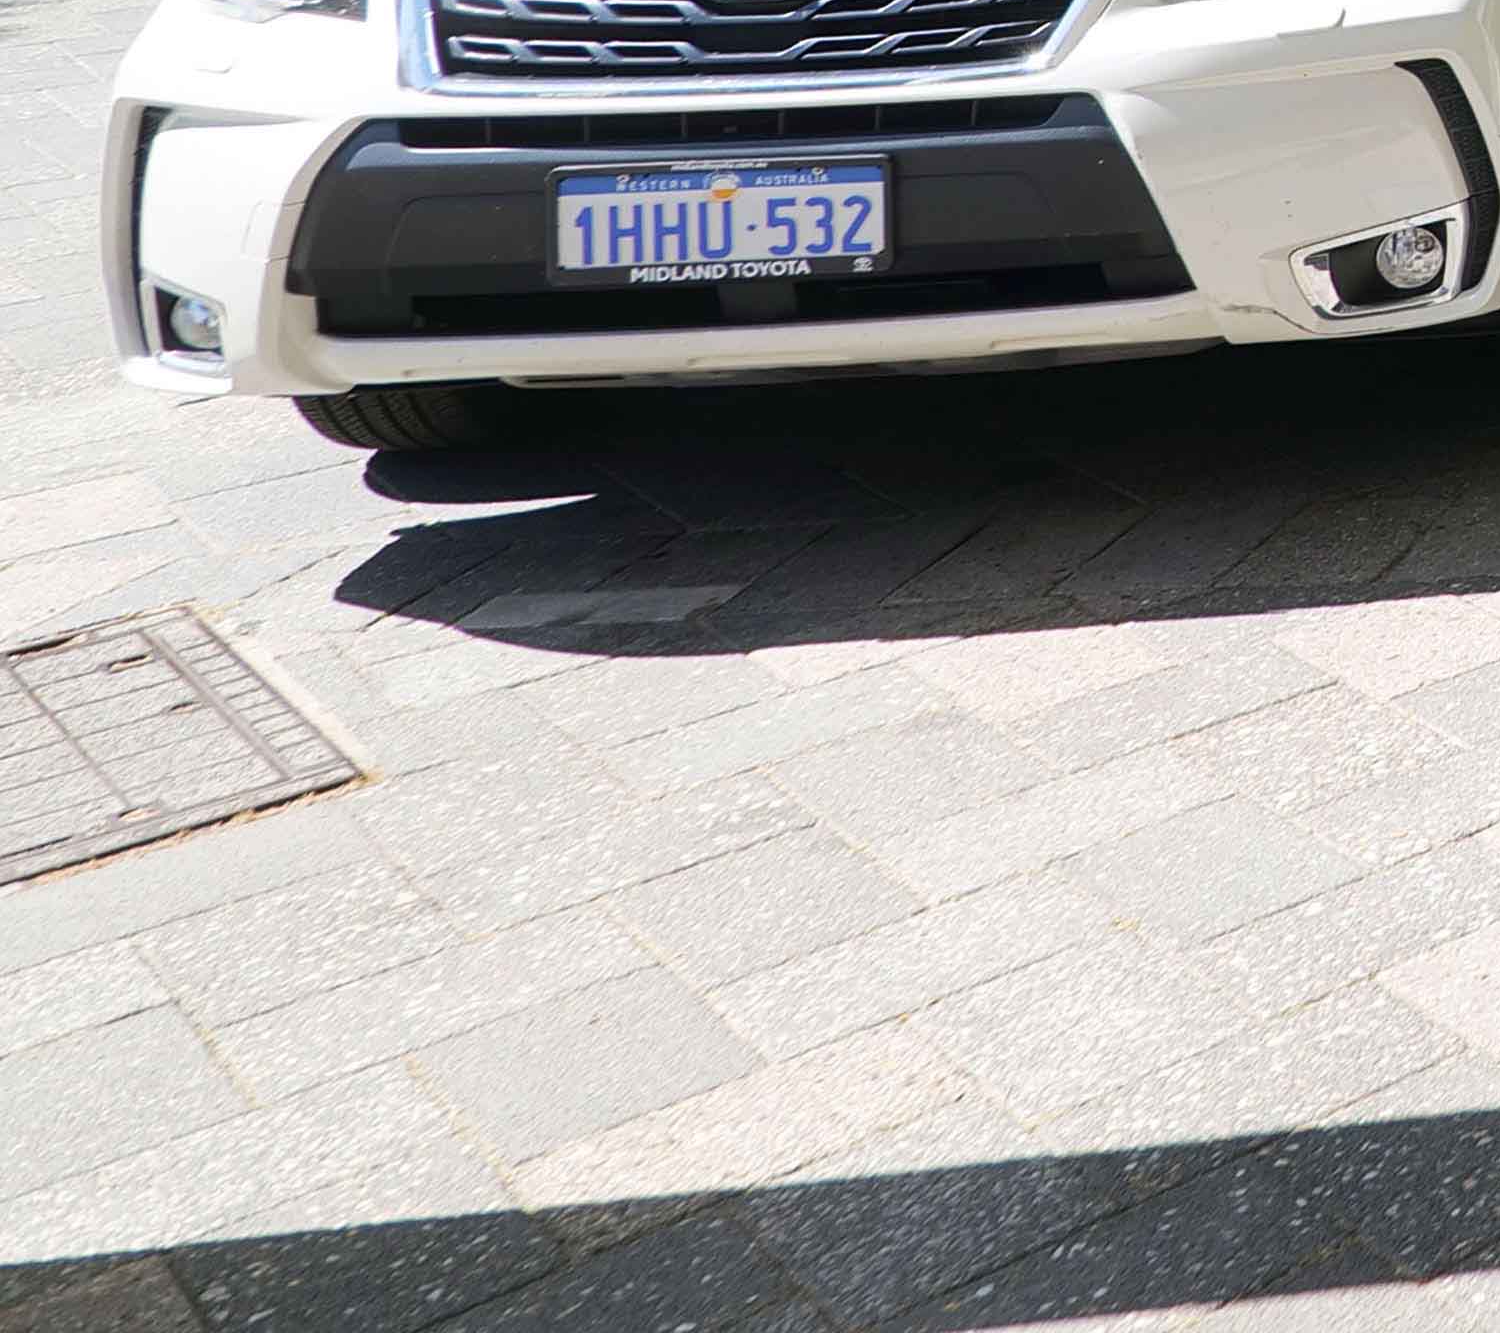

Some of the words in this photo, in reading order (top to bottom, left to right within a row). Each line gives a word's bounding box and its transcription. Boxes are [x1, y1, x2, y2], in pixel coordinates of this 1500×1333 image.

[616, 178, 691, 192] WESTERN
[754, 171, 829, 186] AUSTRALIA
[629, 262, 727, 283] MIDLAND
[731, 258, 812, 278] TOYOTA
